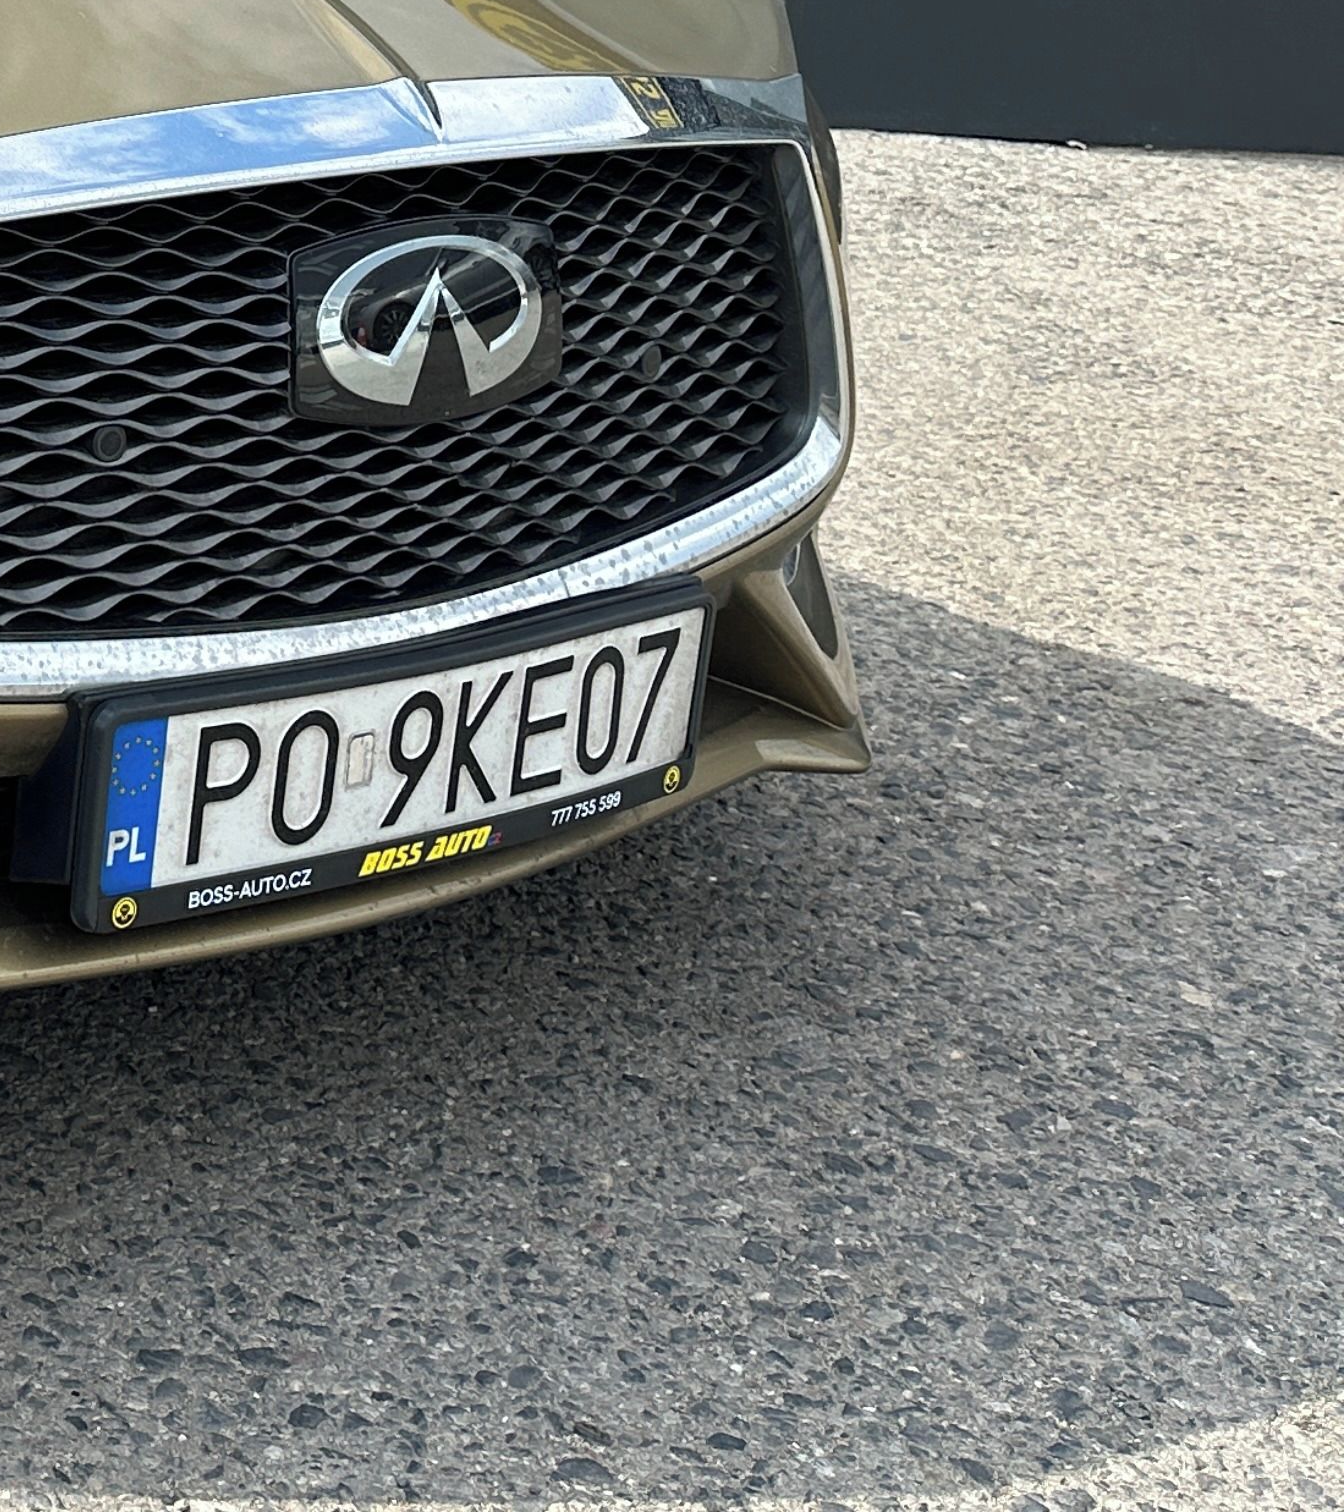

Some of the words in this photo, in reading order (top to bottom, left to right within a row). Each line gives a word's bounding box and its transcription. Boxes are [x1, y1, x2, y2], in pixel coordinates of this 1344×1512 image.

[185, 709, 339, 865] PO
[380, 627, 681, 829] 9KE07
[551, 806, 573, 827] 777
[574, 798, 597, 820] 755
[598, 790, 621, 813] 599
[106, 829, 146, 867] PL
[358, 841, 424, 877] BOSS
[424, 825, 492, 862] AUTO
[188, 869, 312, 909] BOSS-AUTO.CZ
